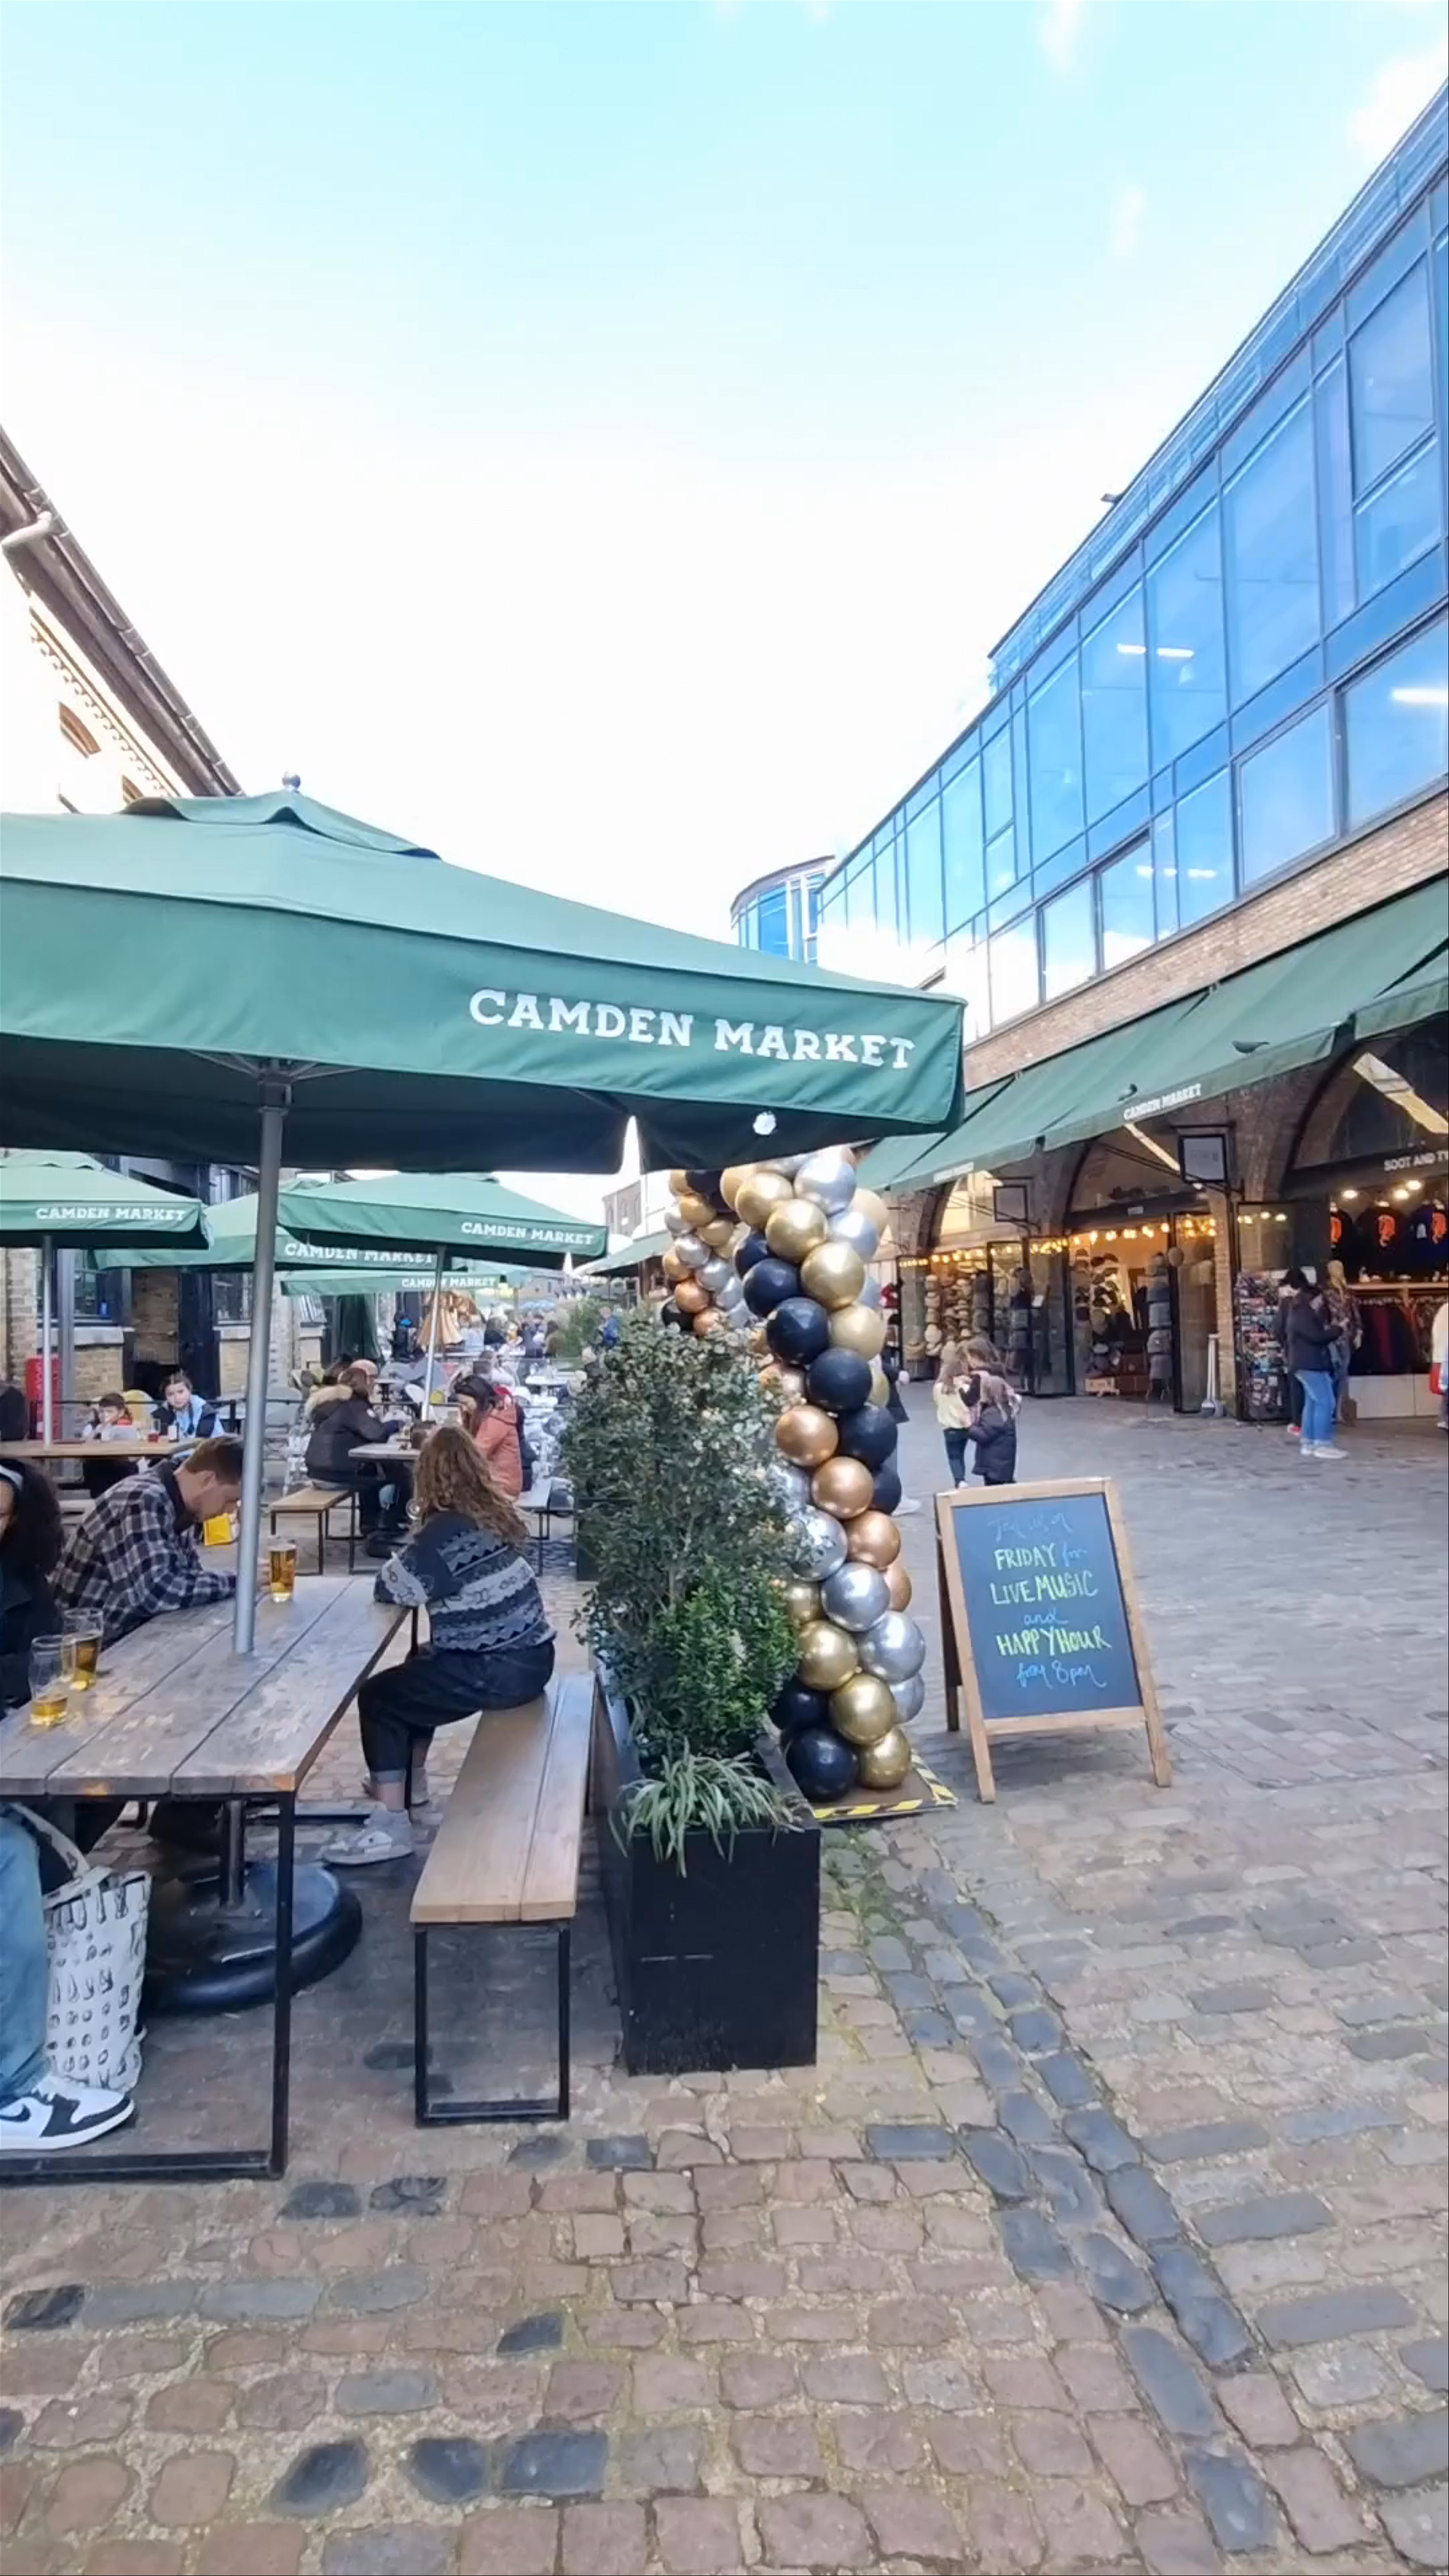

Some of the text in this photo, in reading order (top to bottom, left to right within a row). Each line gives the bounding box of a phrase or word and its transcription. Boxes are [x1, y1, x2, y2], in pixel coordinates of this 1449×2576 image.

[470, 989, 915, 1069] CAMDEN MARKET
[1384, 1156, 1411, 1171] SOOT
[36, 1207, 186, 1221] CAMDEN MARKET
[461, 1222, 595, 1244] CAMDEN MARKET
[449, 1277, 497, 1287] MARKET
[994, 1541, 1088, 1570] FRIDAY for
[989, 1570, 1098, 1604] LIVE MUSIC
[1024, 1606, 1068, 1626] and
[996, 1625, 1112, 1656] HAPPY HOUR
